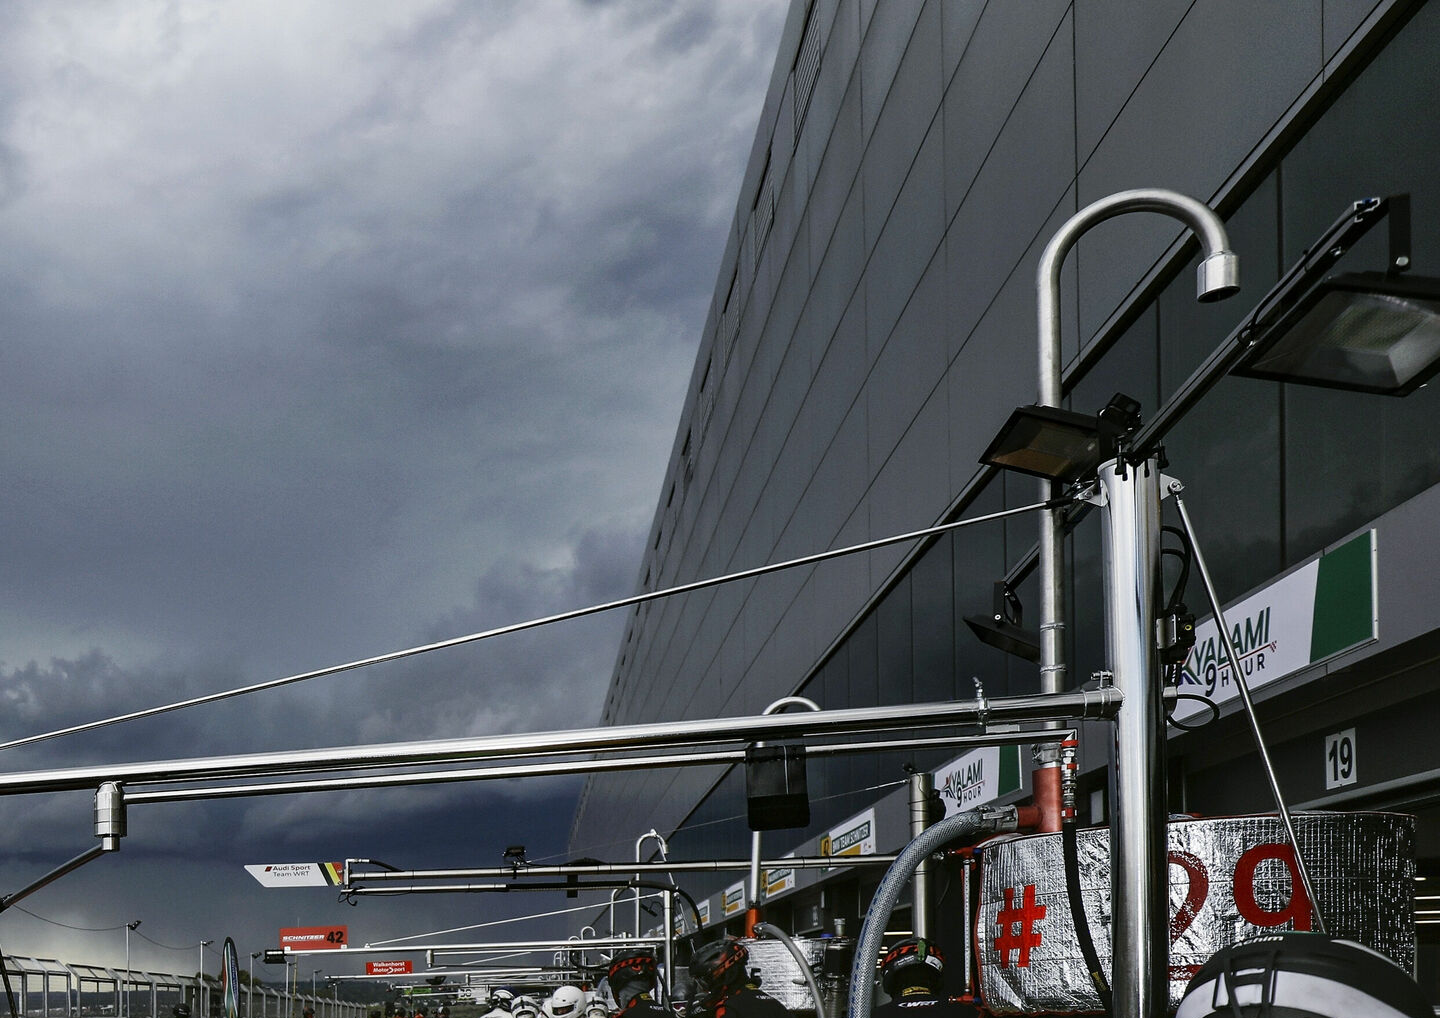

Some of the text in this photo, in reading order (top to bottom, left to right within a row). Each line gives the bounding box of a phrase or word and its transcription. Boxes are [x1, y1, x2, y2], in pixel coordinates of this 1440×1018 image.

[1205, 656, 1217, 697] 9
[1328, 736, 1353, 782] 19
[964, 785, 983, 802] HOUR
[282, 931, 344, 944] SCHNITZER 42
